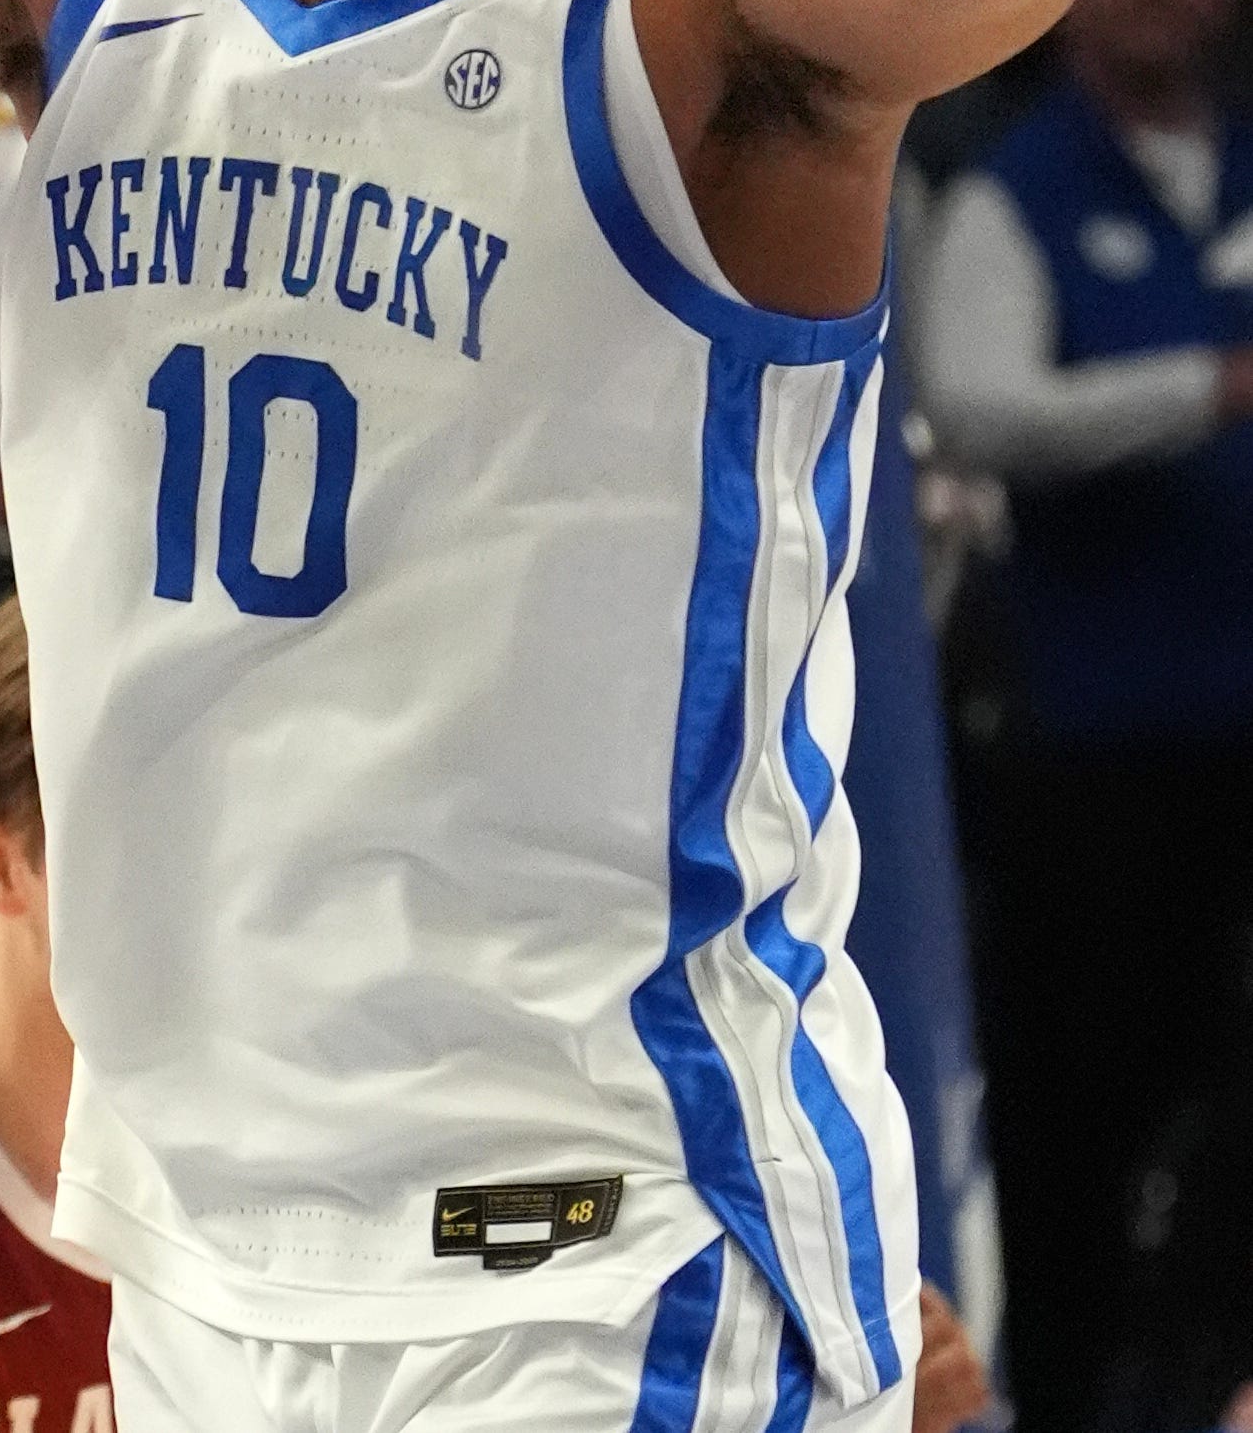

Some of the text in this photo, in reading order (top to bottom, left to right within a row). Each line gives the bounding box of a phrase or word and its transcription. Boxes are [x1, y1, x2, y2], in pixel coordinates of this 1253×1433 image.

[447, 51, 500, 108] SEC
[46, 157, 508, 362] KENTUCKY
[147, 344, 357, 618] 10
[440, 1223, 477, 1236] ELITE
[566, 1199, 595, 1224] 48
